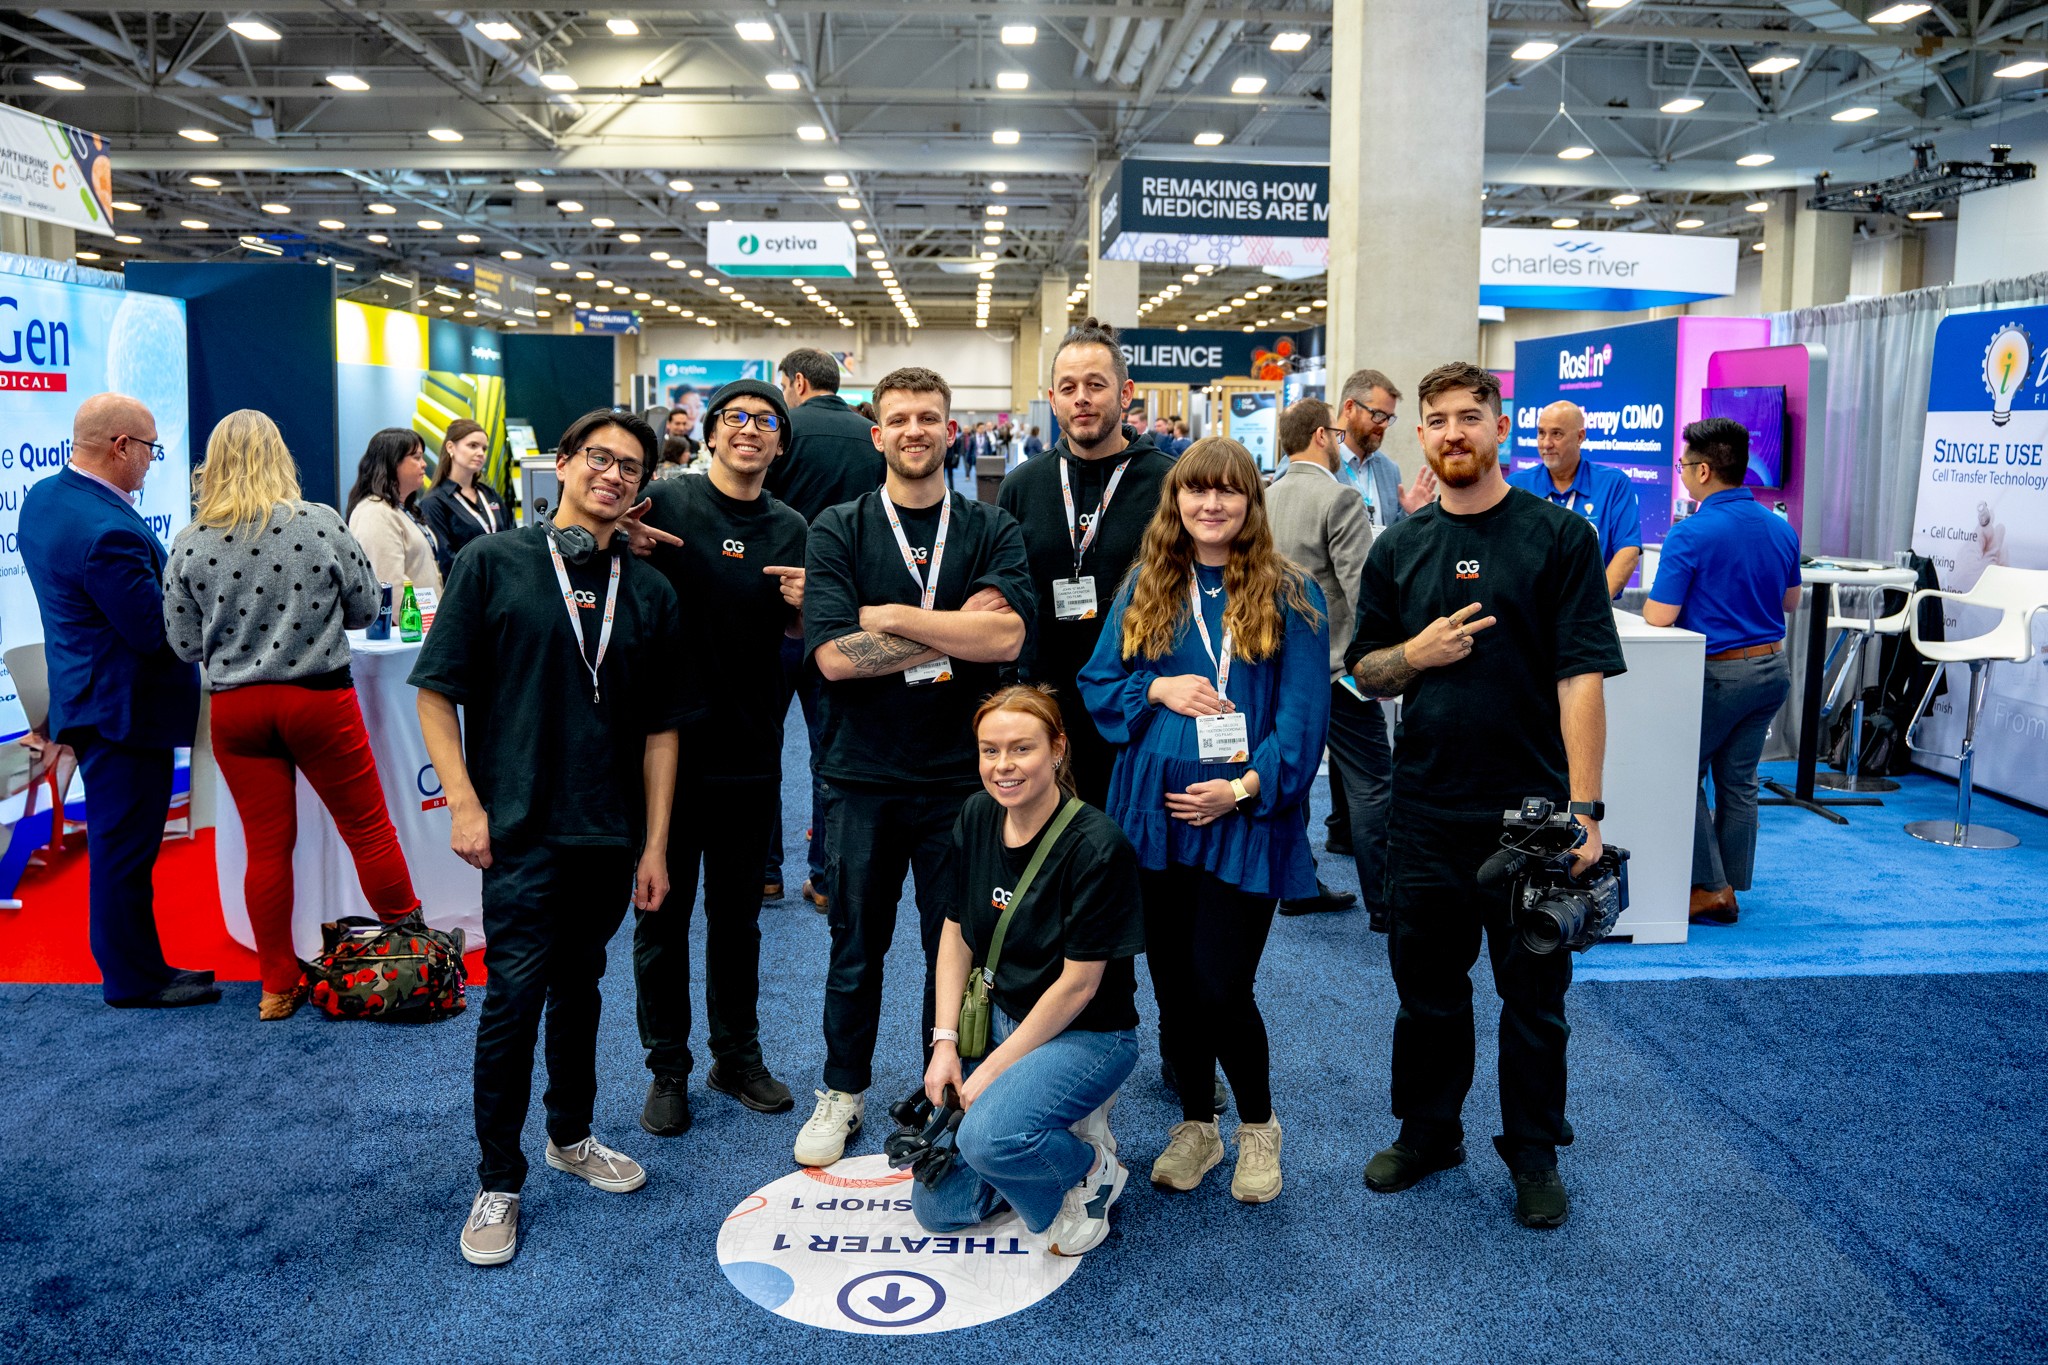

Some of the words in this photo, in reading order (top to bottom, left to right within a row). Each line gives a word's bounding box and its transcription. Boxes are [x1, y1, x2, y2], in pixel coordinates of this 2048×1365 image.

[0, 148, 49, 170] ARTNERING
[53, 164, 66, 190] C
[1142, 177, 1258, 199] REMAKING
[1263, 181, 1317, 201] HOW
[1142, 197, 1262, 219] MEDICINES
[1265, 202, 1308, 221] ARE
[765, 235, 818, 253] cytiva
[1491, 254, 1582, 276] charles
[1588, 256, 1639, 278] river
[1517, 407, 1536, 429] Cell
[1583, 406, 1621, 435] herapy
[1622, 403, 1664, 429] CDMO
[20, 439, 73, 471] Quali
[1933, 438, 2000, 465] SINGLE
[2005, 444, 2043, 466] USE
[1932, 468, 1949, 482] Cell
[1951, 469, 1987, 484] Transfer
[1989, 471, 2048, 491] Technology
[1930, 525, 1946, 539] Cell
[1947, 527, 1978, 542] Culture
[722, 539, 745, 553] OG
[722, 550, 744, 559] FILMS
[1455, 559, 1480, 574] OG
[573, 590, 596, 604] OG
[1933, 701, 1953, 715] inish
[1993, 702, 2046, 739] From
[991, 899, 1007, 911] FILM
[790, 1197, 805, 1210] 1
[772, 1234, 792, 1251] 1
[808, 1234, 1030, 1255] THEATER
